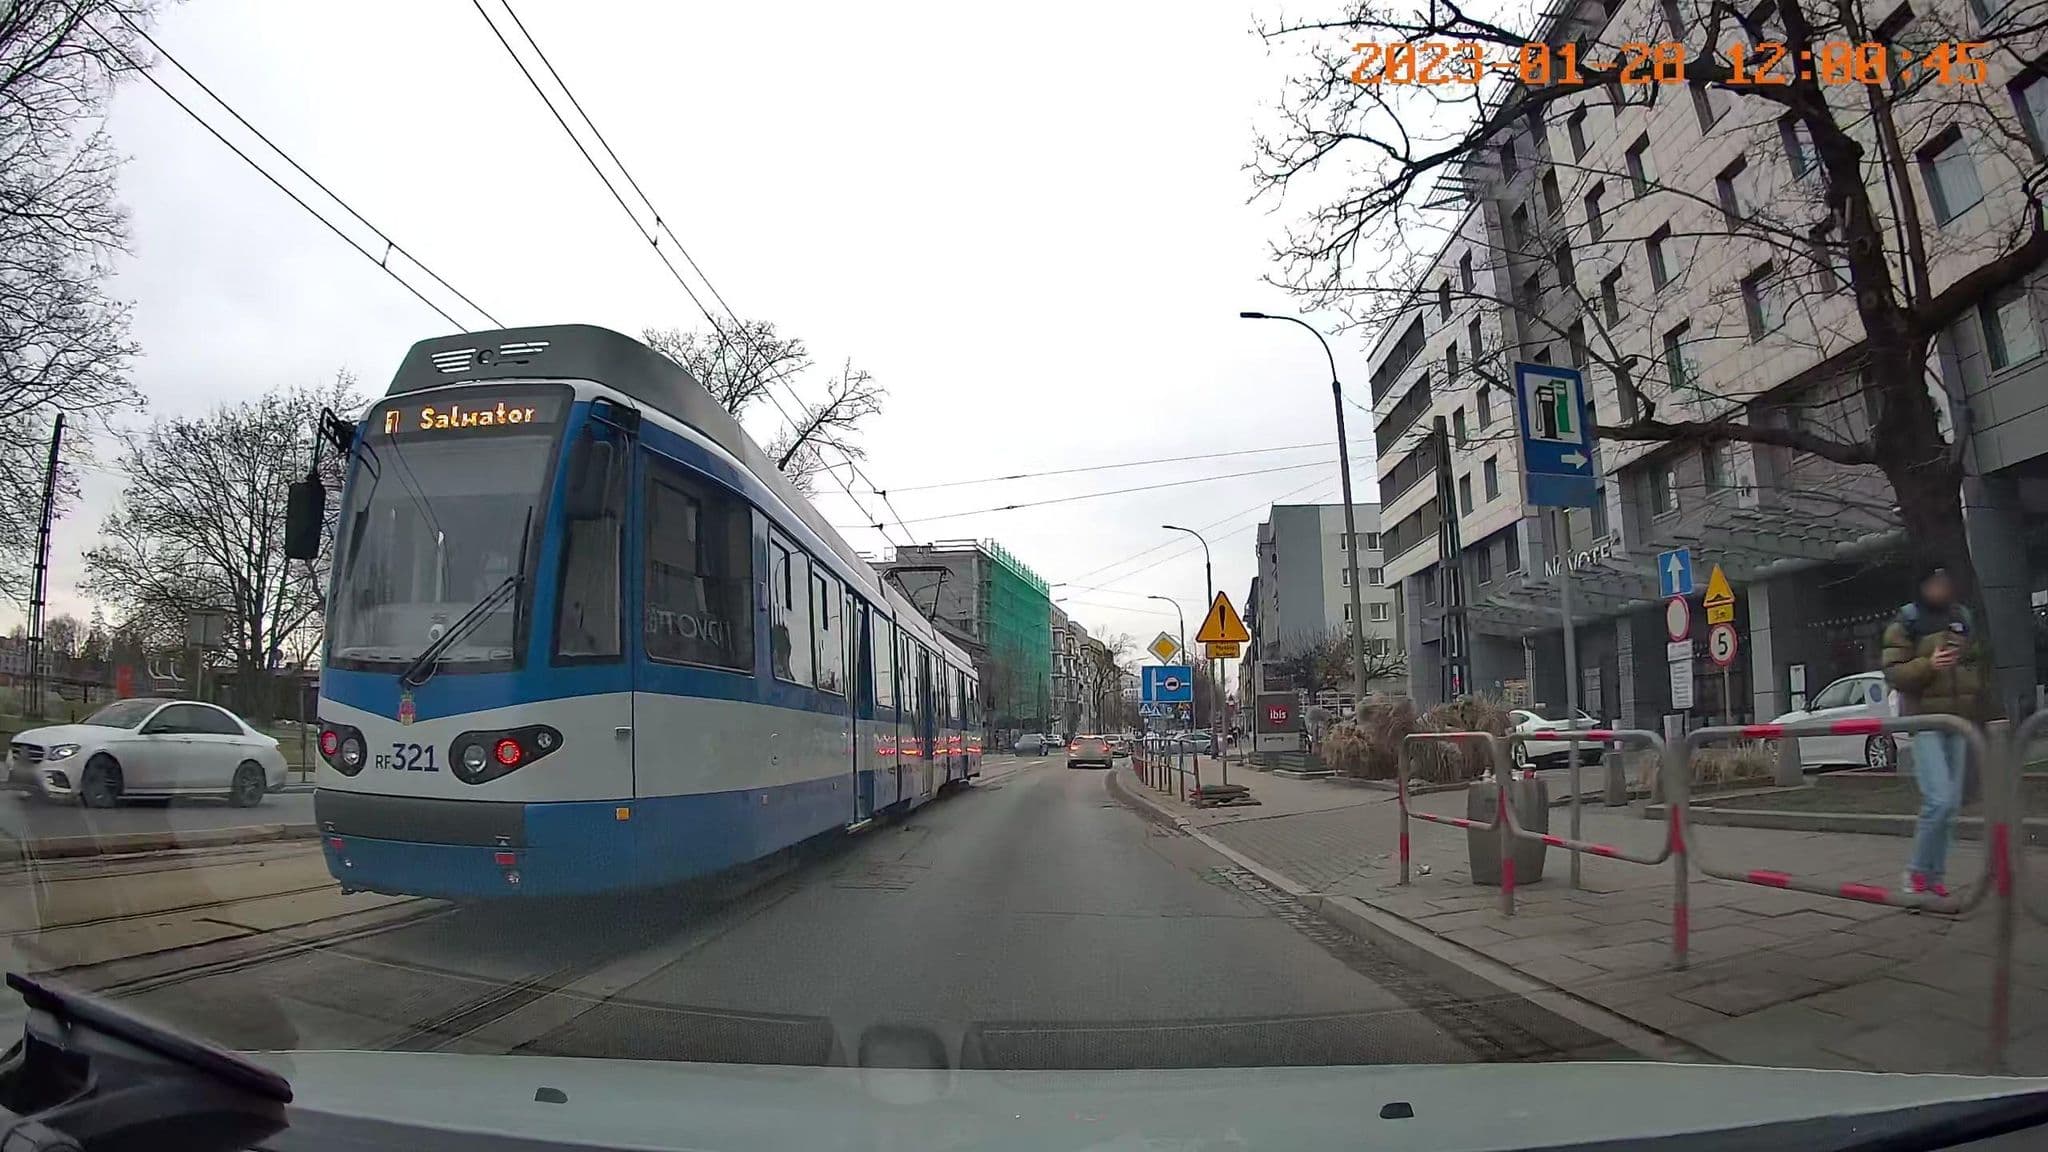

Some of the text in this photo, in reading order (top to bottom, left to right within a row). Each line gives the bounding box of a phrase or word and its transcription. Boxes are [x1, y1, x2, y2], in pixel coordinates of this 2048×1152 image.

[420, 402, 535, 430] Salwator
[1718, 632, 1728, 655] 5
[1270, 709, 1287, 719] ibis
